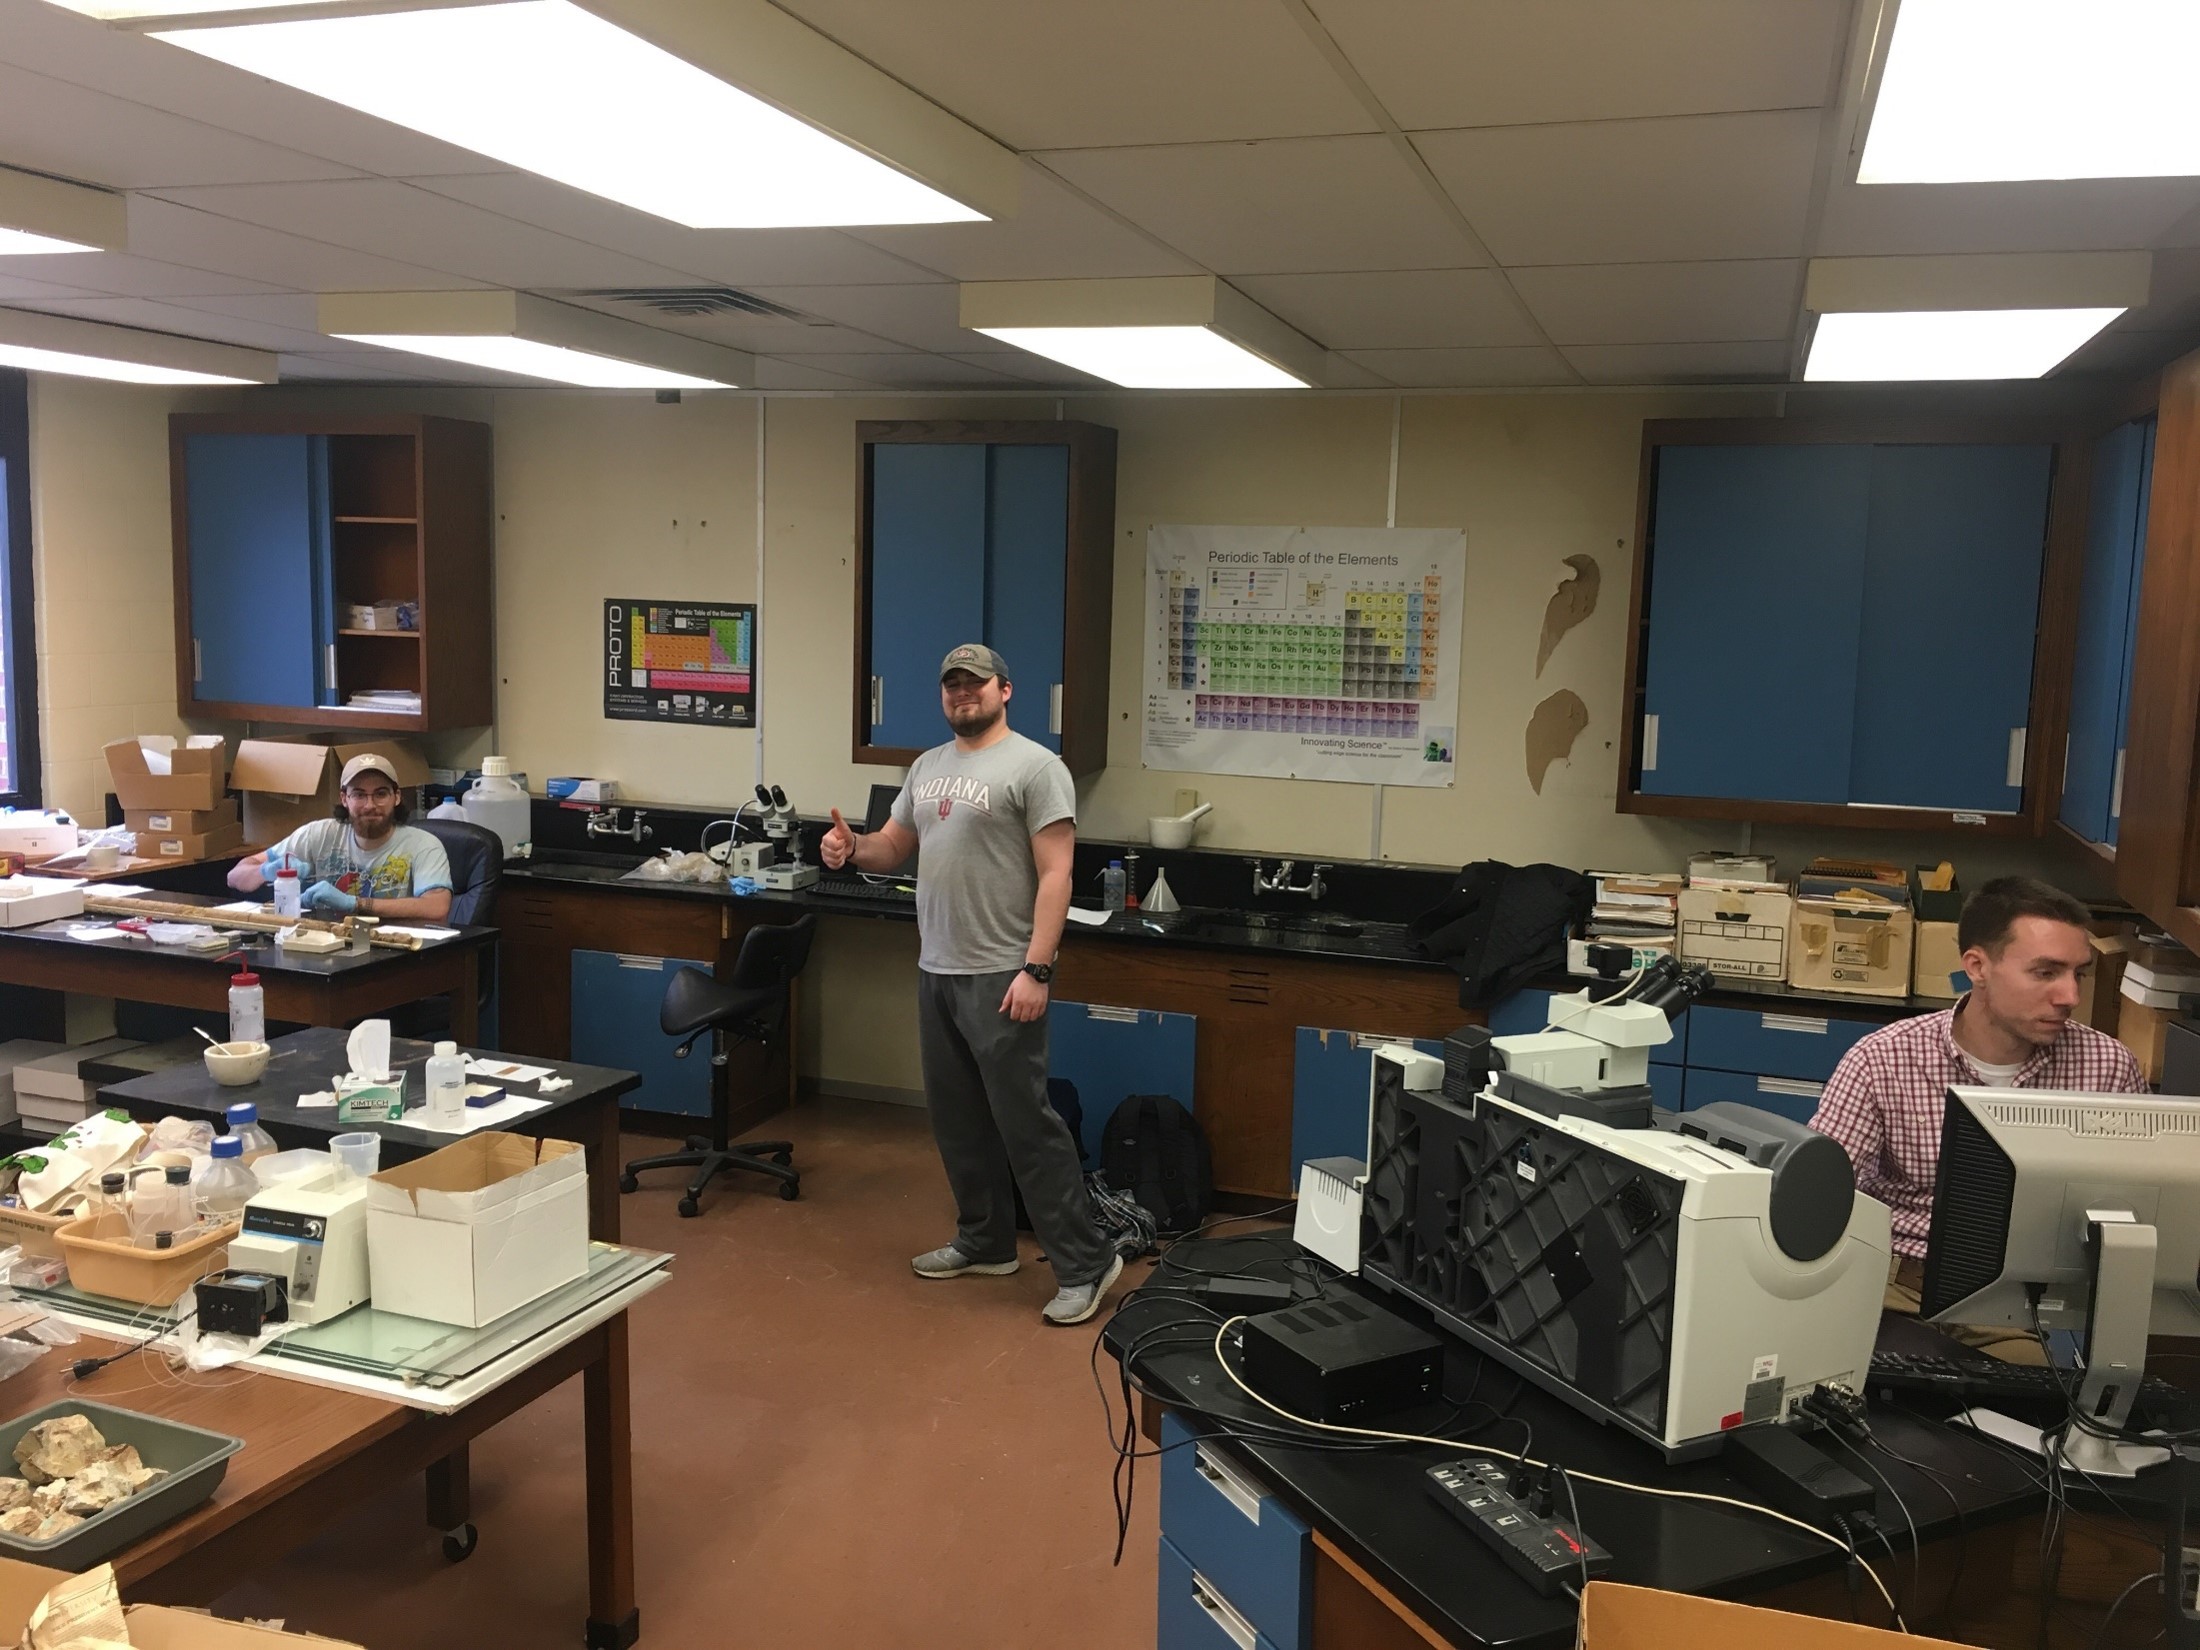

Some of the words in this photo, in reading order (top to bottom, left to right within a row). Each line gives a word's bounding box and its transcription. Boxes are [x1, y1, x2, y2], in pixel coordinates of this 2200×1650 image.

[1209, 551, 1259, 563] Periodic
[1262, 552, 1295, 564] Table
[1299, 553, 1312, 564] of
[1314, 553, 1333, 564] the
[1338, 553, 1398, 565] Elements
[609, 606, 622, 687] PROTO
[1330, 704, 1339, 712] Dy
[1301, 737, 1345, 749] Innovating
[913, 775, 991, 811] INDIANA
[1713, 962, 1746, 971] STOR-ALL
[350, 1099, 389, 1107] KIMTECH
